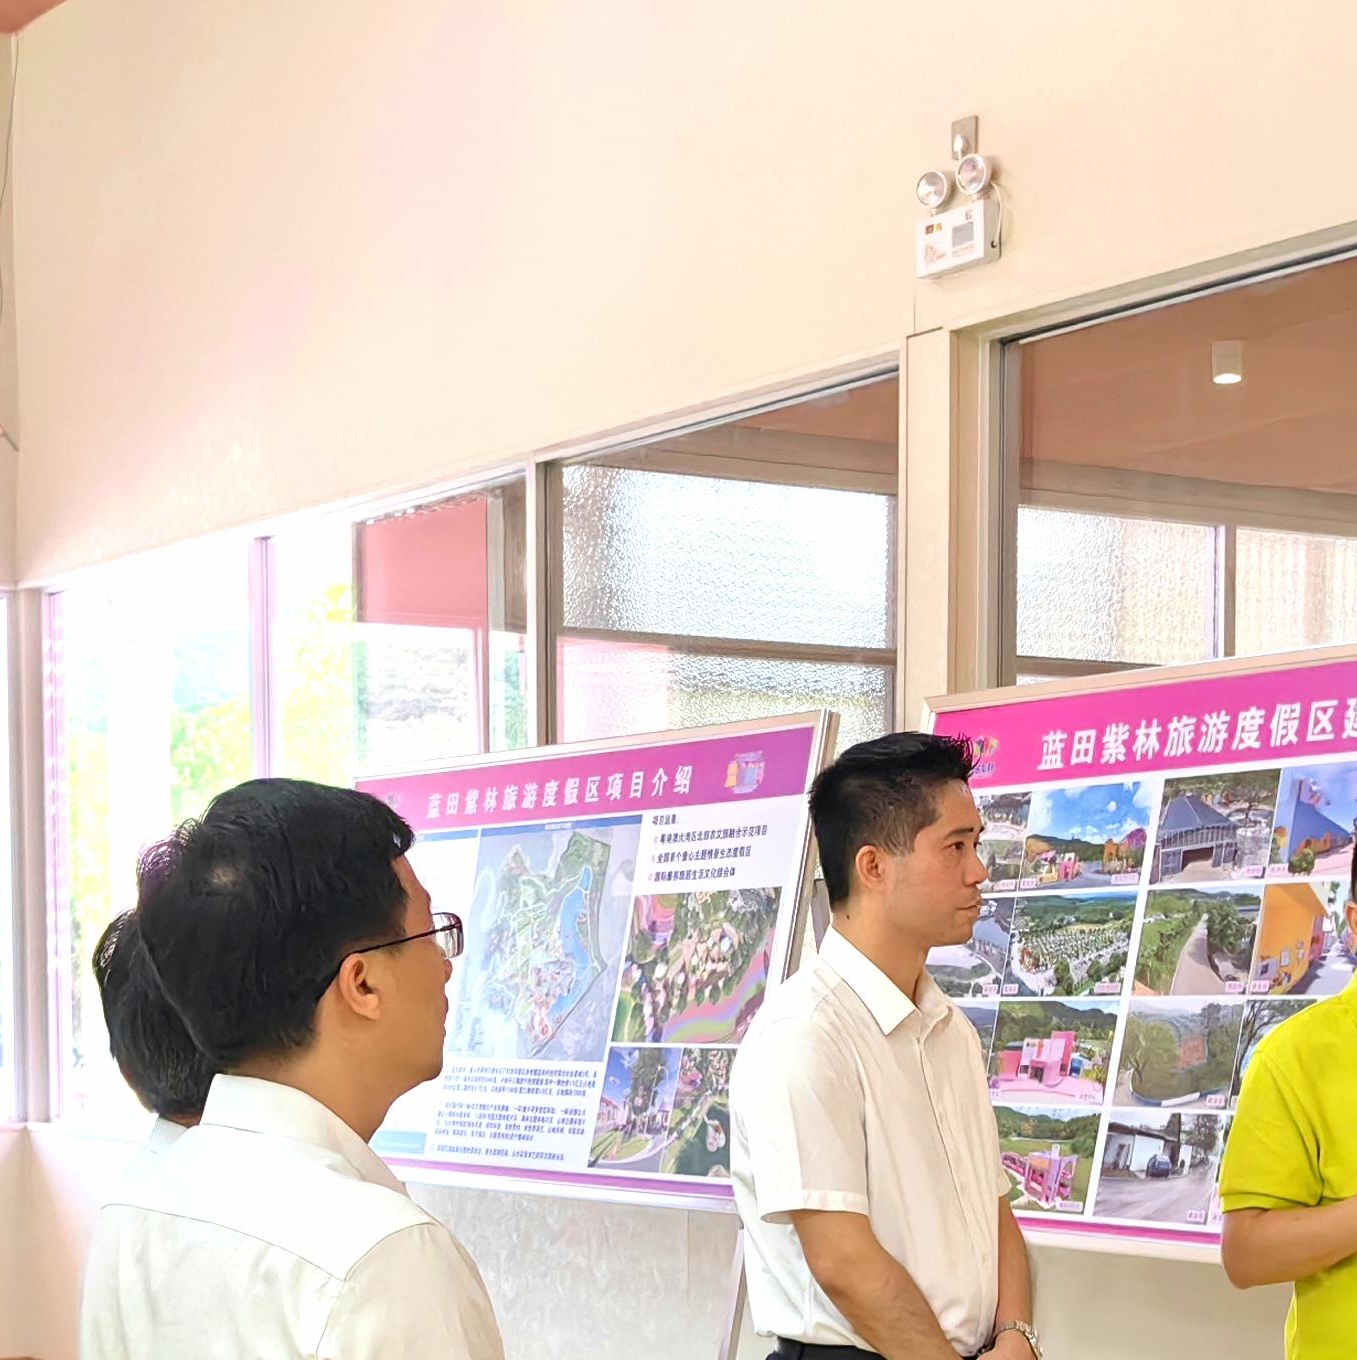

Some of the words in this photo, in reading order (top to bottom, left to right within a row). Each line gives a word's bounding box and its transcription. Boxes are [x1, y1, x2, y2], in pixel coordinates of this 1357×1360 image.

[426, 765, 692, 819] 蓝田紫林旅游度假区项目介绍
